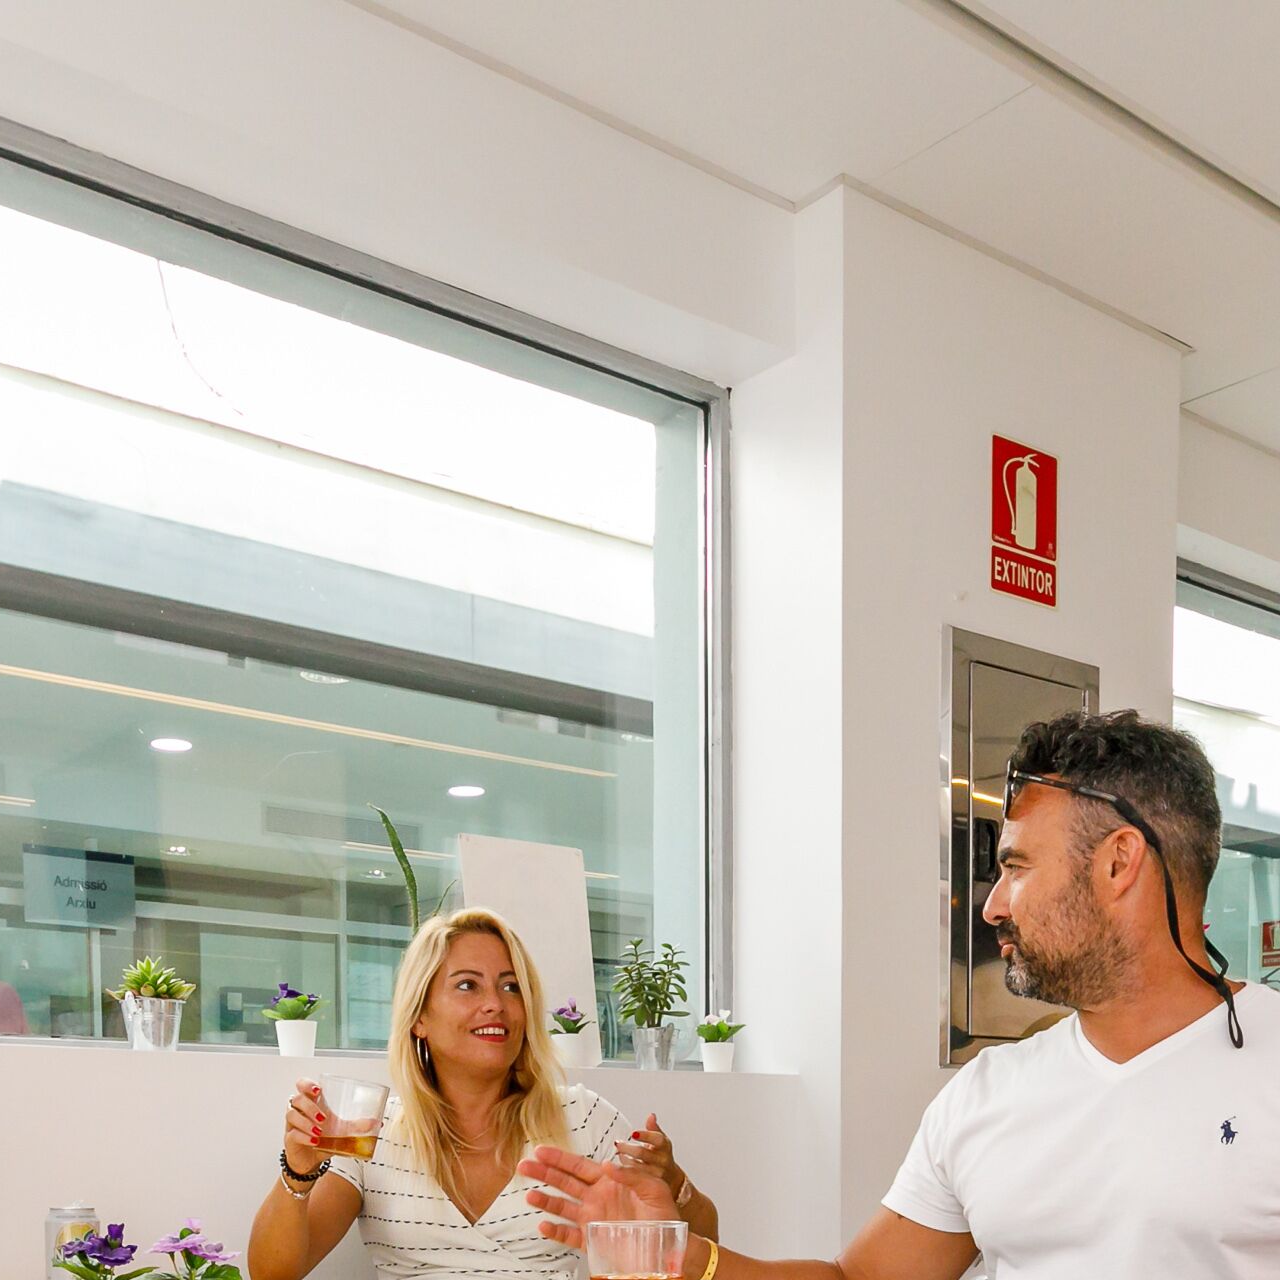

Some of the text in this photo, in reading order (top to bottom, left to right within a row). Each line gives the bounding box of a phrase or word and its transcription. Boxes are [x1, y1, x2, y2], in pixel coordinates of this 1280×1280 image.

[994, 555, 1054, 597] EXTINTOR
[53, 874, 108, 892] Admissió
[65, 895, 96, 910] Arxiu
